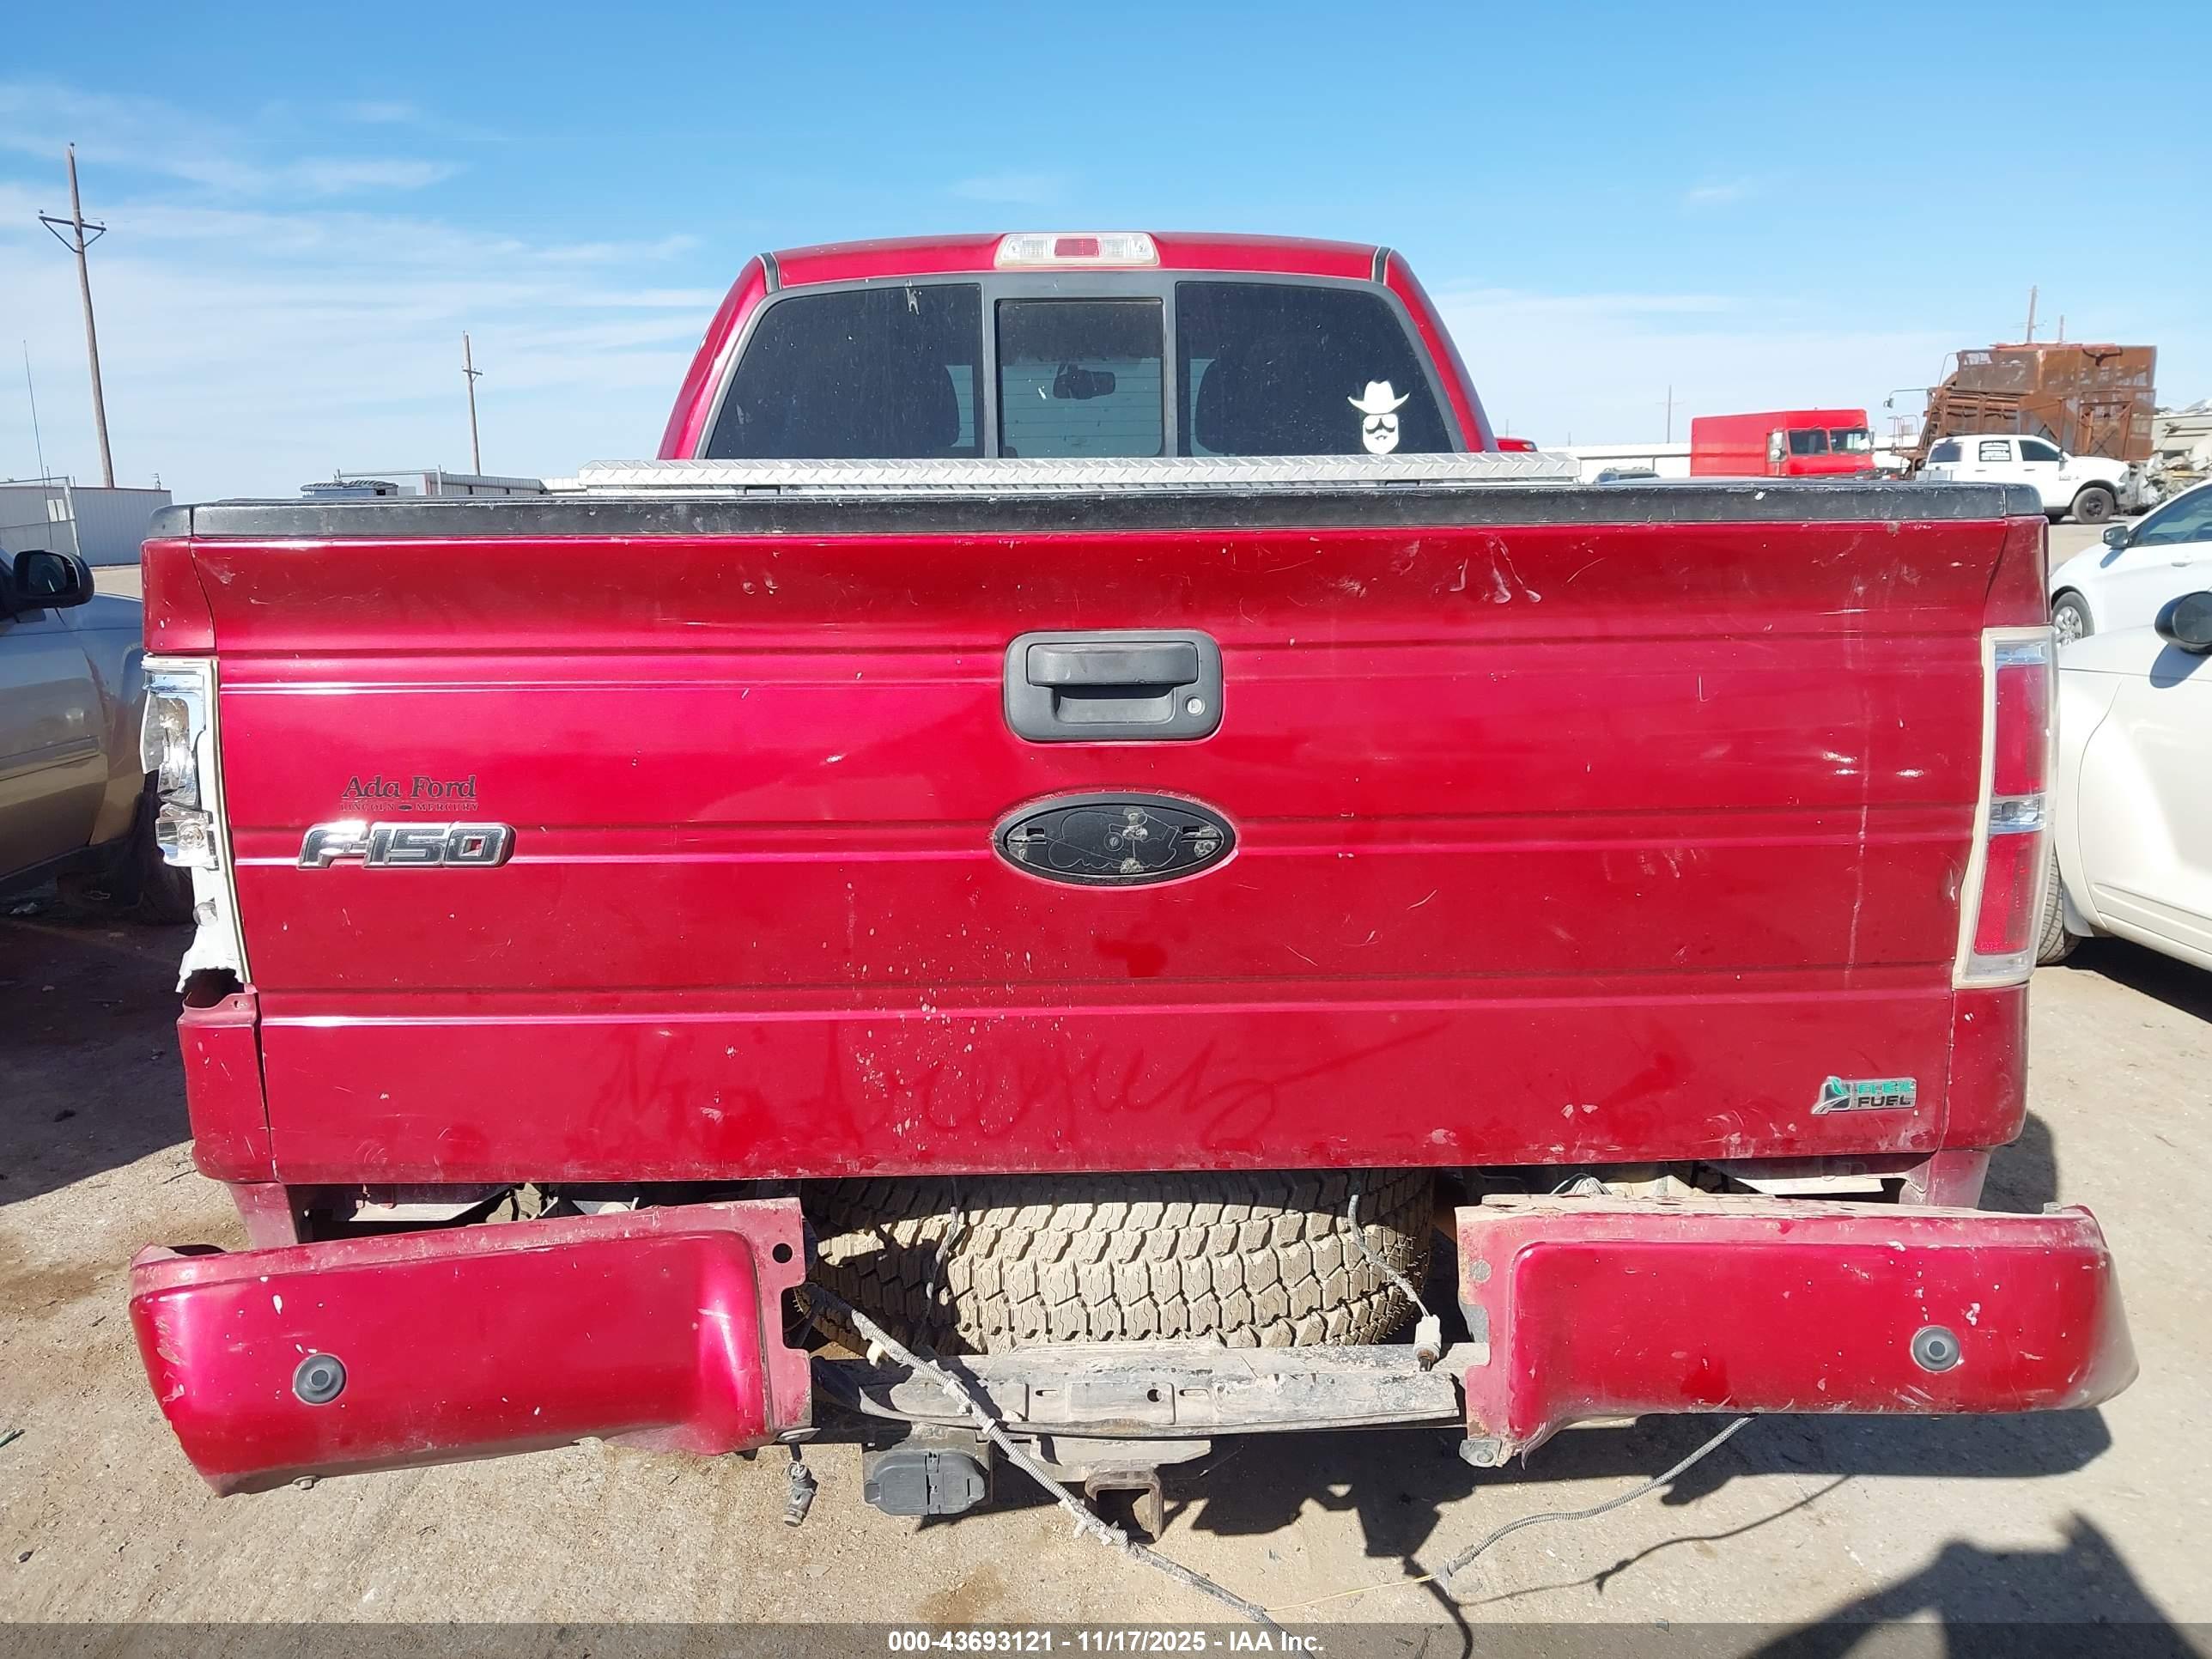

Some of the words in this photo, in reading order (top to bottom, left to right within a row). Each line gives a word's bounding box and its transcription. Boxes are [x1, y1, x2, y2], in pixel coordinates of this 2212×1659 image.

[341, 775, 401, 799] Ada
[410, 775, 477, 799] Ford
[339, 802, 395, 812] LINCOLN
[416, 802, 478, 812] MERCURY
[297, 822, 515, 870] F-150
[1857, 1095, 1911, 1107] FUEL
